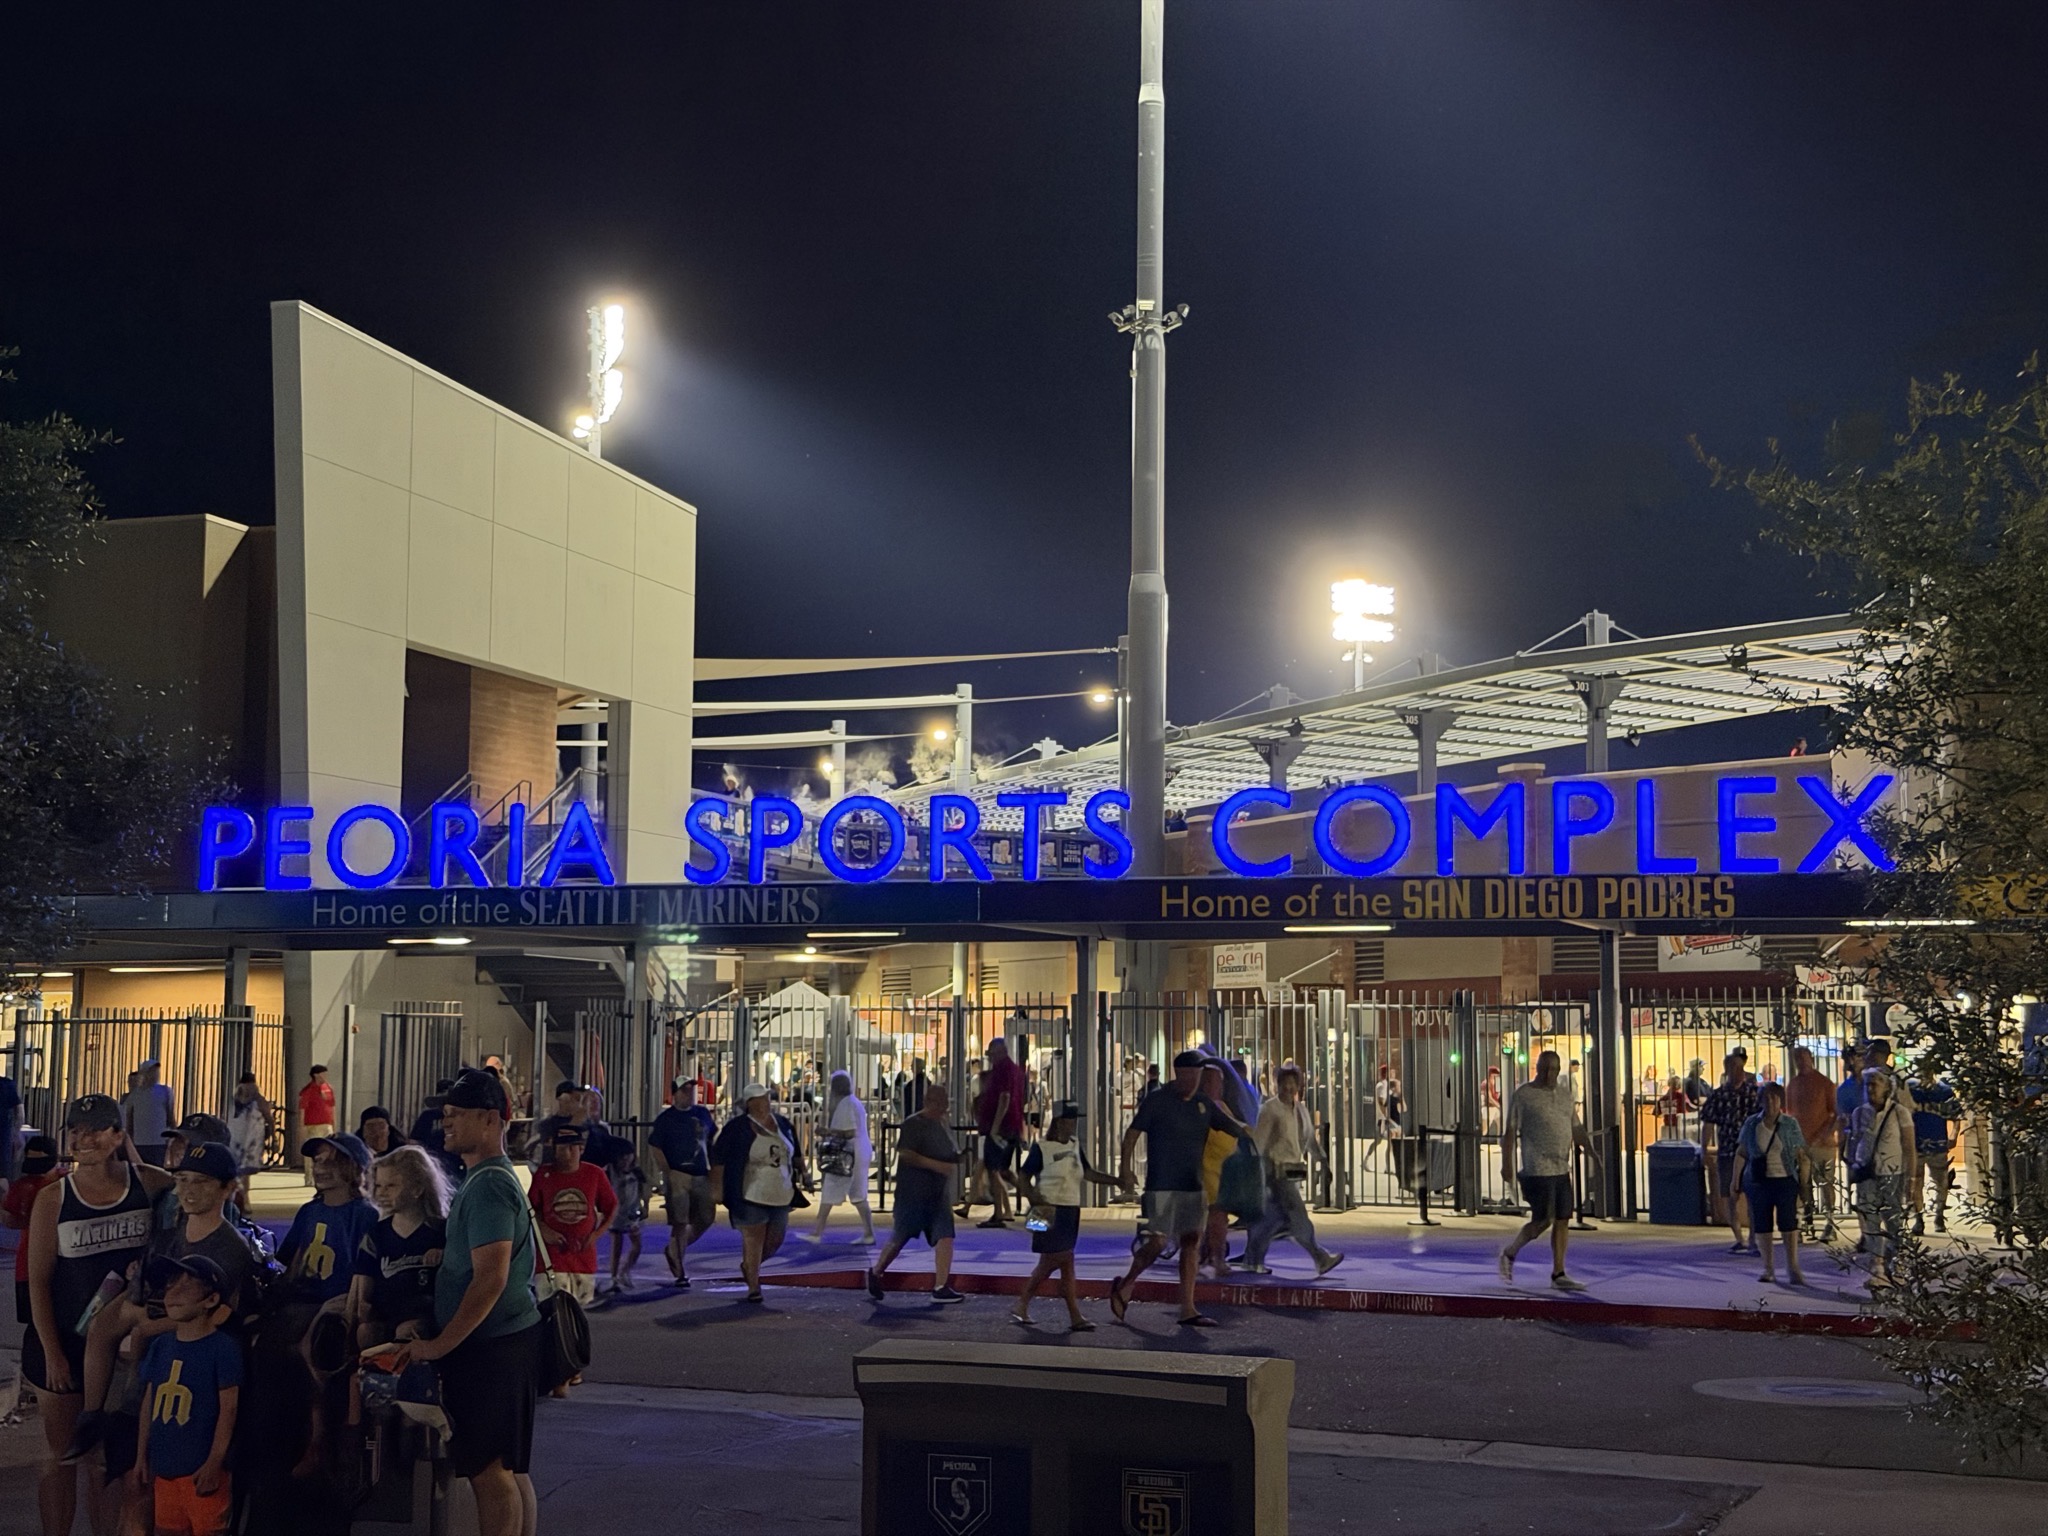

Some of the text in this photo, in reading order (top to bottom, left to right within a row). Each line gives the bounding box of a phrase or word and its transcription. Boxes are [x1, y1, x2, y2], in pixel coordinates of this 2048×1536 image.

[199, 774, 1896, 892] PEORIA SPORTS COMPLEX
[312, 887, 820, 926] Home of the SEATTLE MARINERS
[1161, 876, 1735, 919] Home of the SAN DIEGO PADRES
[1657, 1009, 1755, 1029] FRANKS
[1220, 1287, 1263, 1305] FIRE
[1277, 1288, 1325, 1307] LANE
[1349, 1291, 1368, 1309] NO
